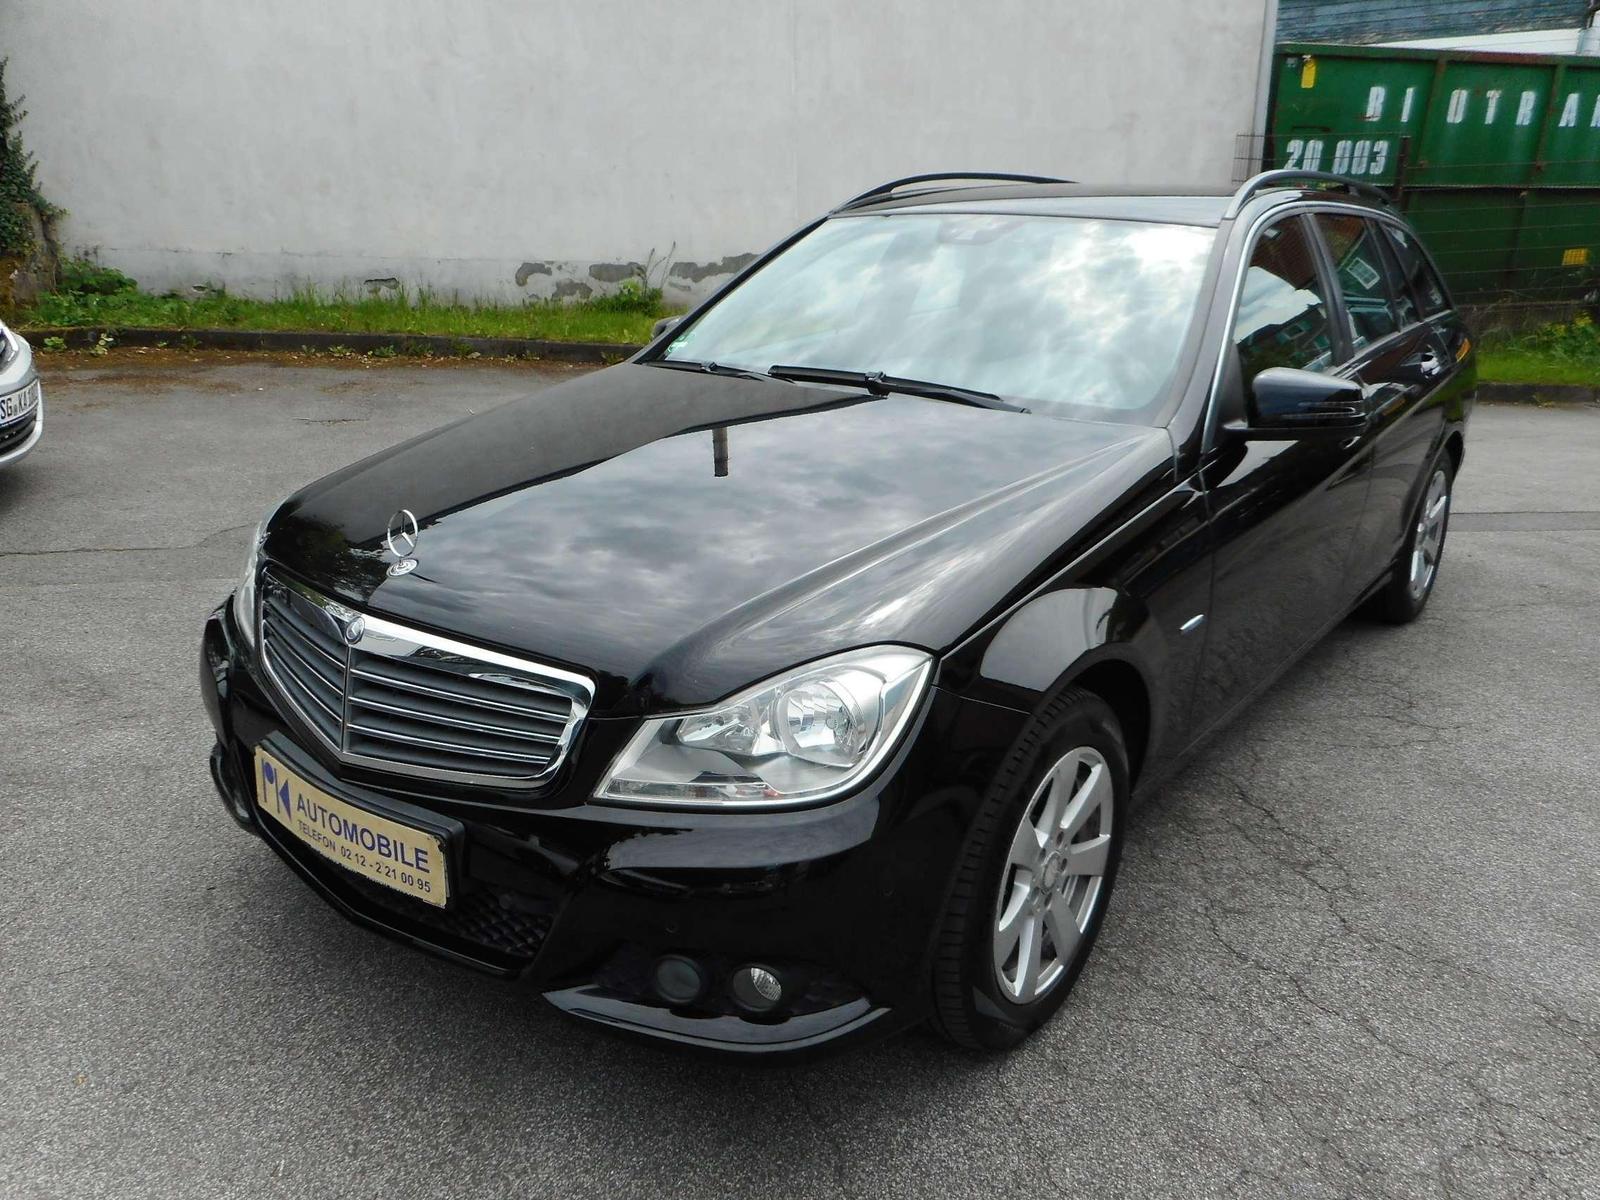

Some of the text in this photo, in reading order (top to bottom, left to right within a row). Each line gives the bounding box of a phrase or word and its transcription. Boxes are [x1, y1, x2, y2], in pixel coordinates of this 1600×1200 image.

[1283, 139, 1324, 172] 20
[296, 793, 430, 874] AUTOMOBILE
[297, 819, 336, 852] TELEFON
